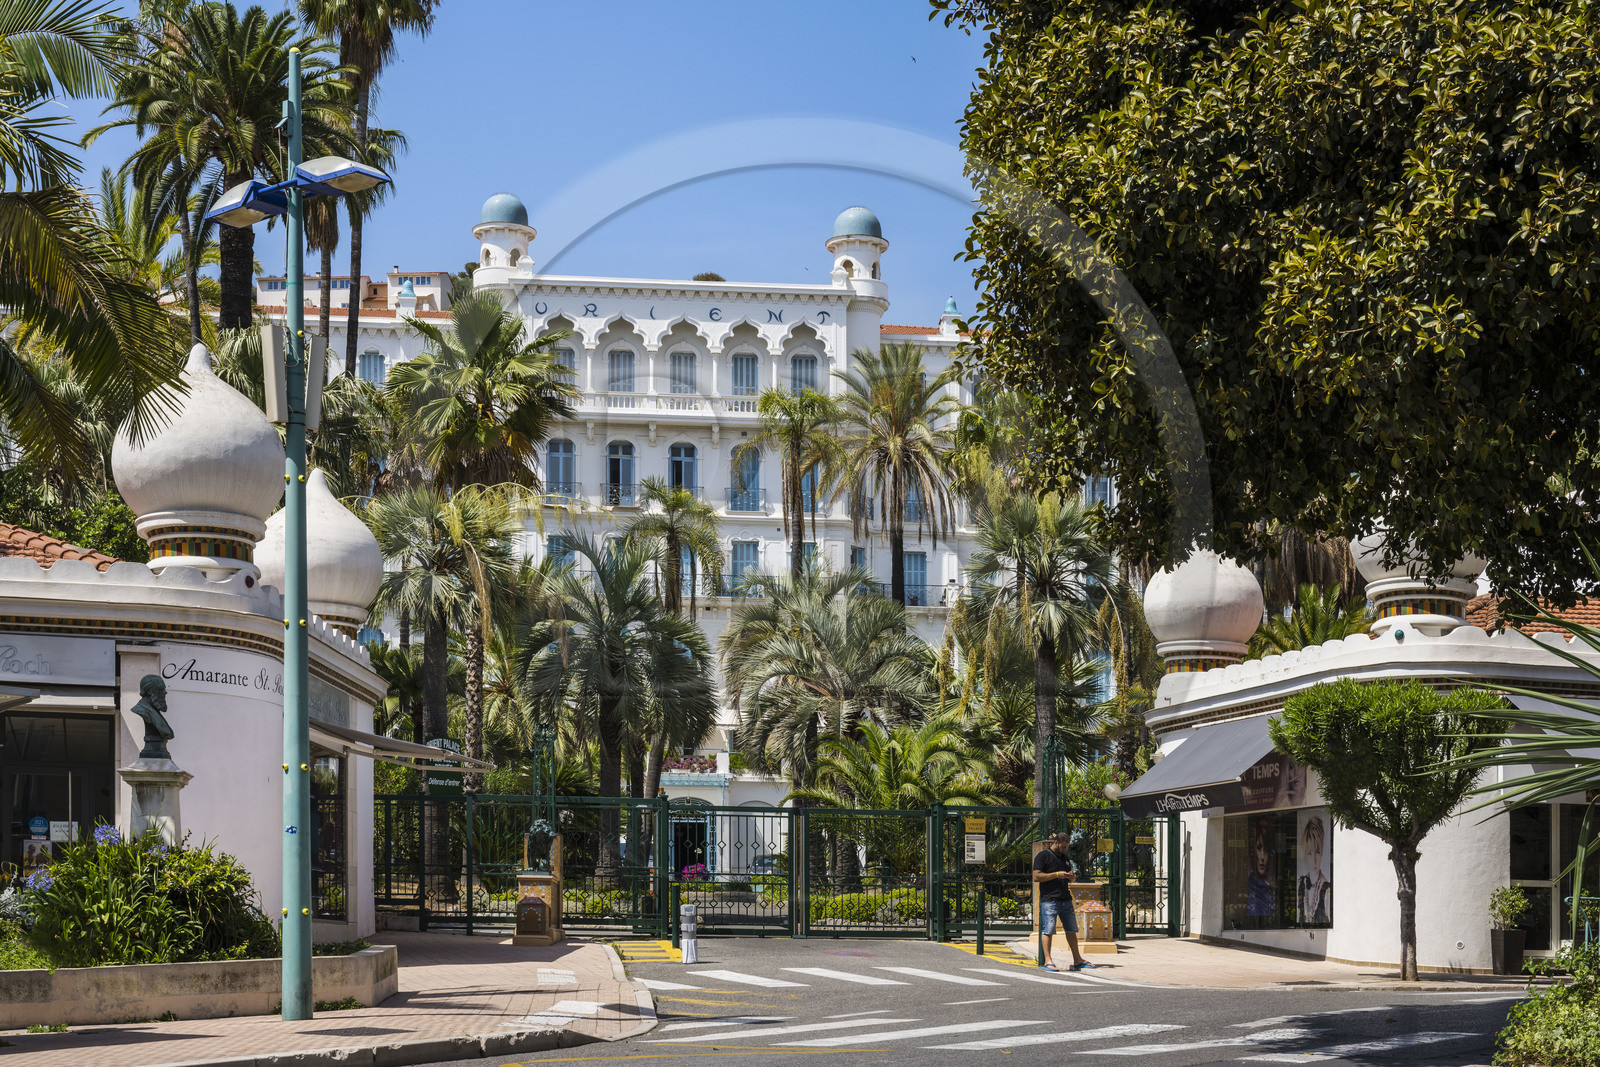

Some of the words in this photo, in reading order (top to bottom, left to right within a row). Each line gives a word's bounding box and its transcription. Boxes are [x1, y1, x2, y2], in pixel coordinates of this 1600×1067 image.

[162, 658, 249, 687] Amarante
[254, 667, 270, 691] St.
[443, 738, 461, 754] PALACE
[1252, 762, 1280, 780] TEMPS
[428, 777, 445, 786] Défense
